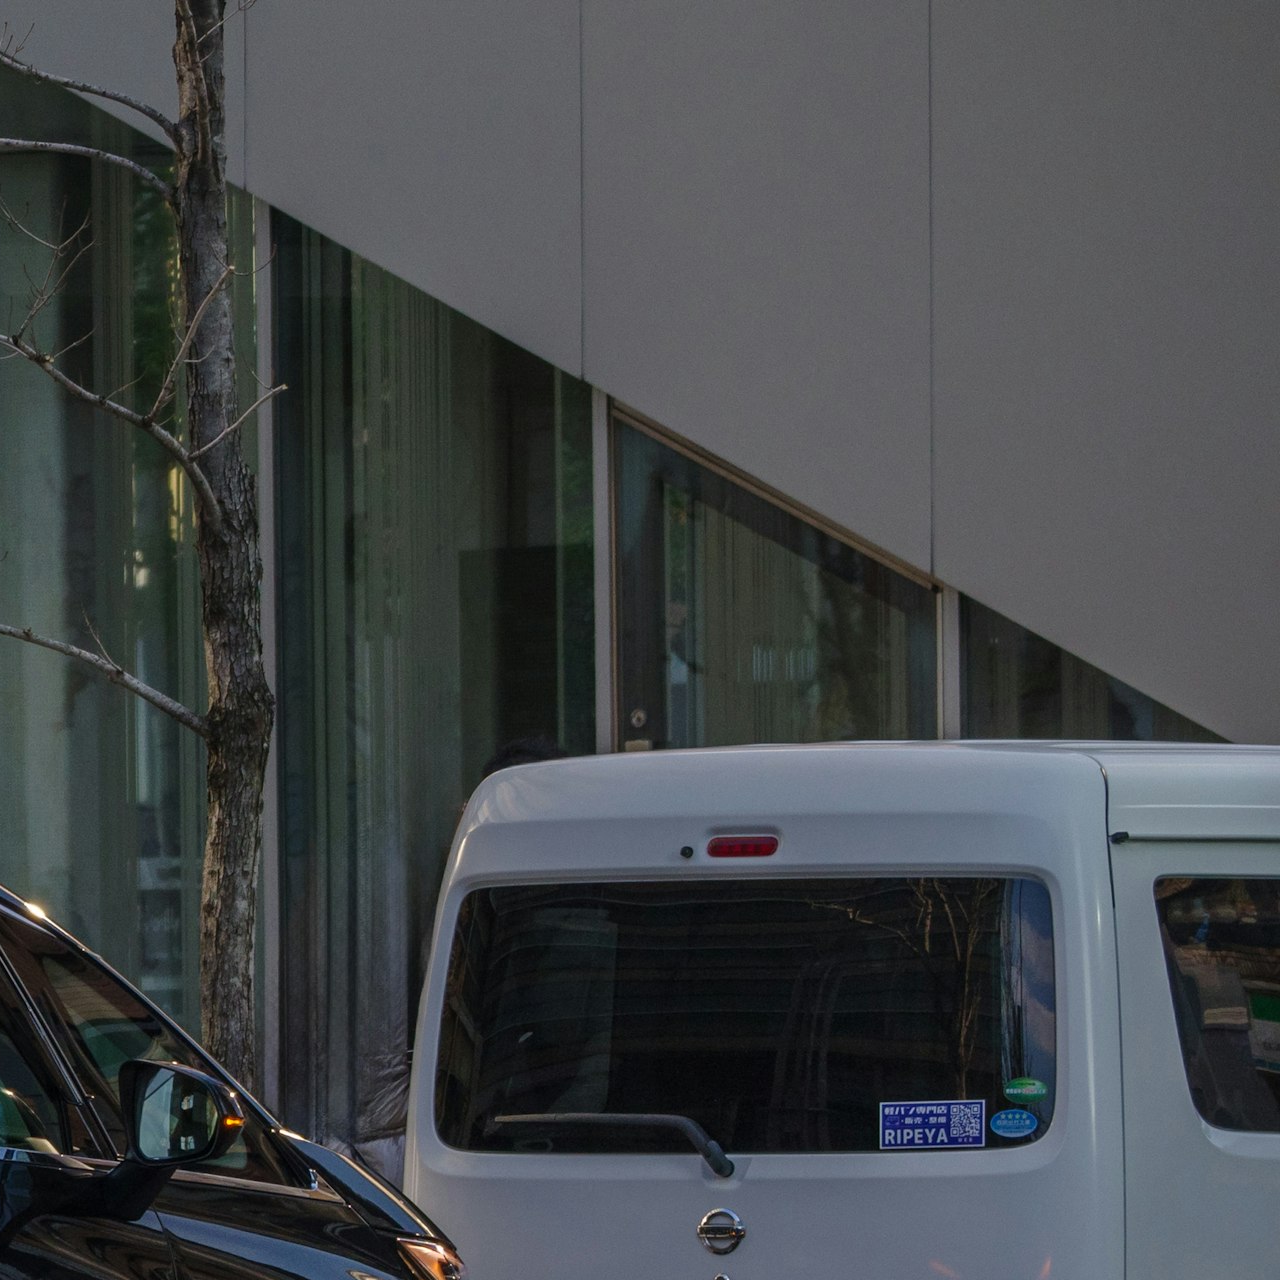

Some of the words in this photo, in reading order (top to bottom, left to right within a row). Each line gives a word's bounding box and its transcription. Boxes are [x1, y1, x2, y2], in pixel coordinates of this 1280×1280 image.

[884, 1105, 947, 1115] 軽バン専門店
[884, 1128, 948, 1145] RIPEYA
